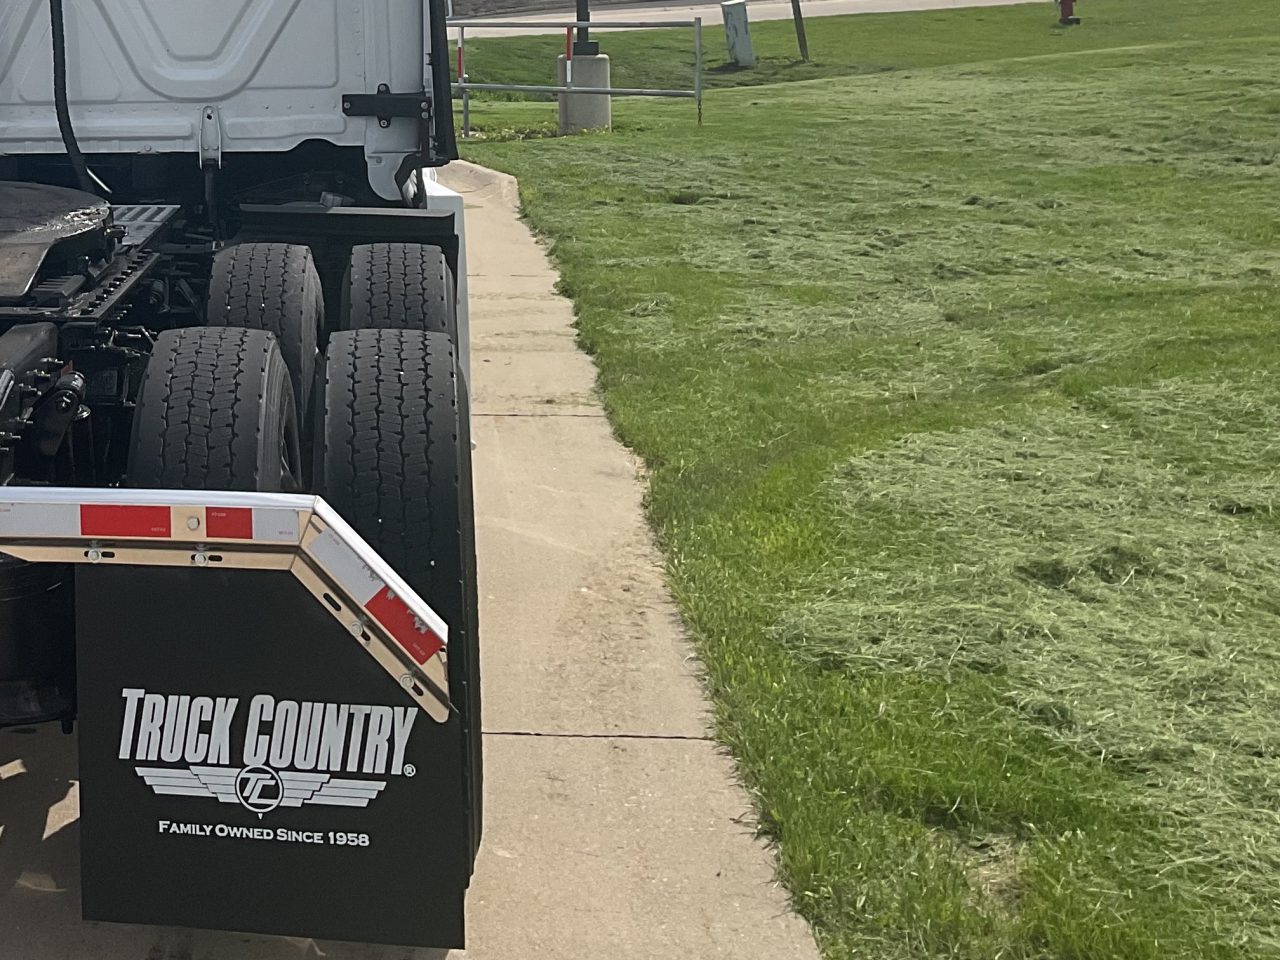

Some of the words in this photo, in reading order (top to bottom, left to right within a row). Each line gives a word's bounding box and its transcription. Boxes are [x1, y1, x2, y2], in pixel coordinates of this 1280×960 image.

[119, 688, 239, 764] TRUCK
[158, 820, 213, 836] FAMILY
[215, 824, 273, 840] OWNED
[276, 828, 324, 844] SINCE
[328, 831, 370, 847] 1958
